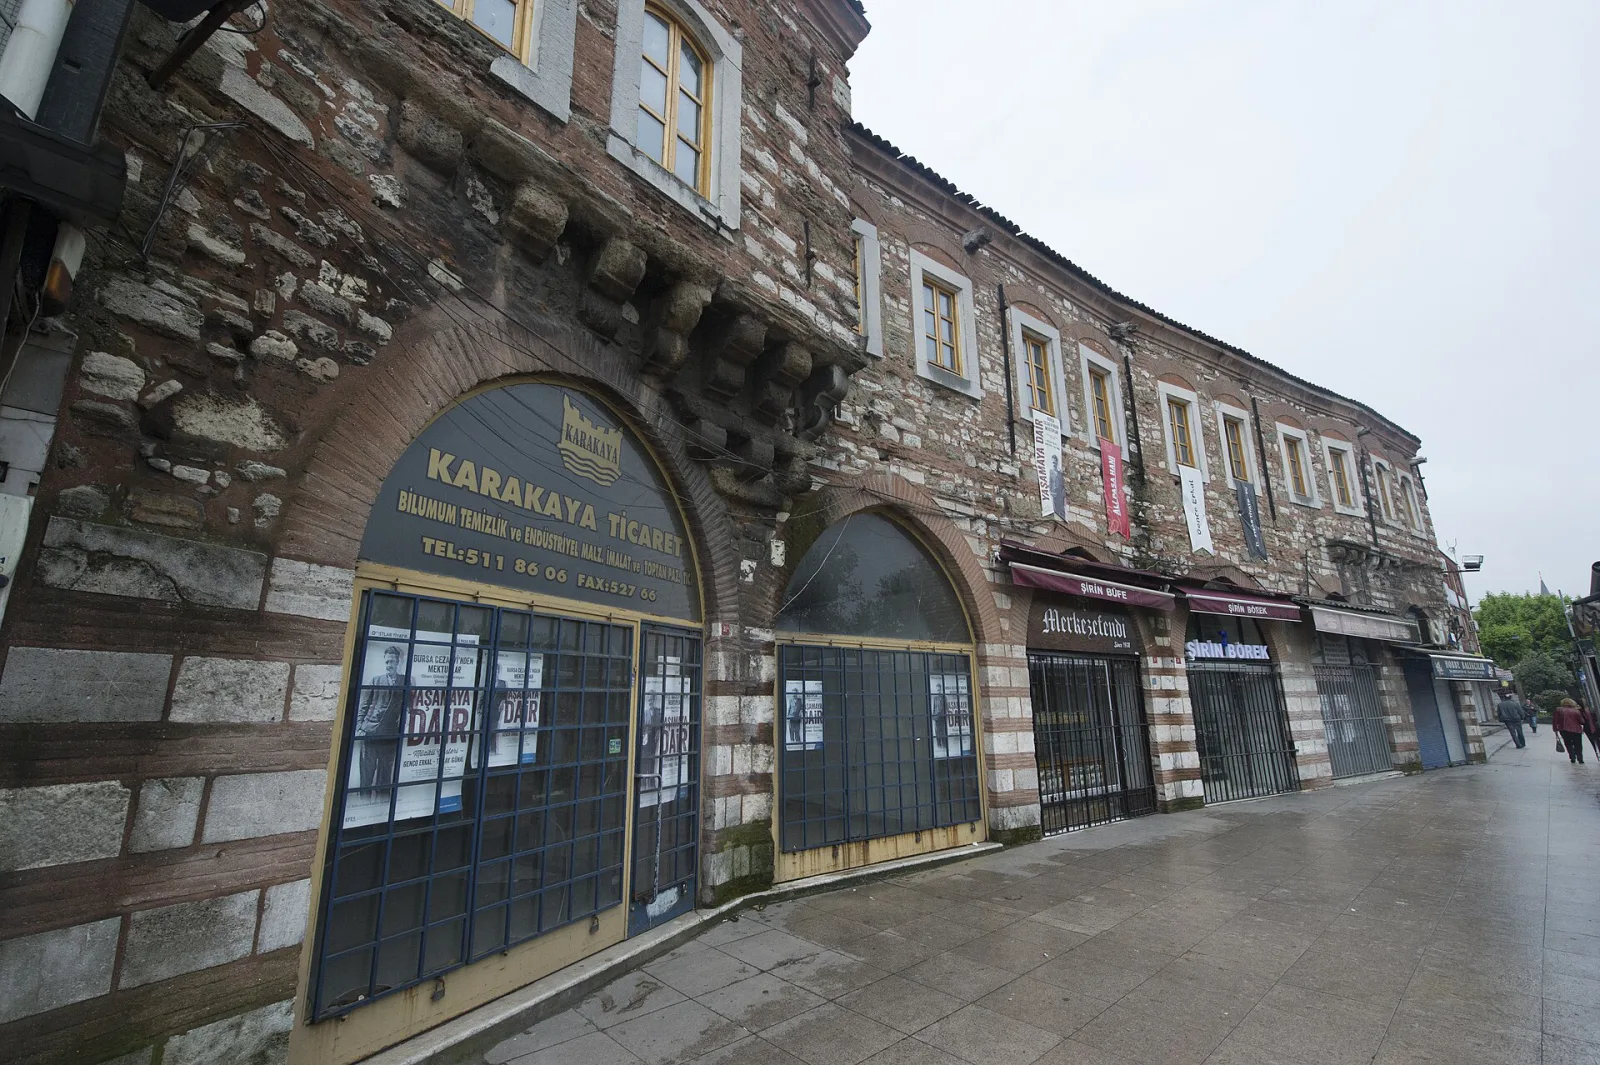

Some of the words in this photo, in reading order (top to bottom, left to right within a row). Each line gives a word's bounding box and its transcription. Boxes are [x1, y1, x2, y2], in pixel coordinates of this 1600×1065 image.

[565, 423, 618, 465] KARAKAYA
[427, 447, 597, 531] KARAKAYA
[608, 510, 683, 557] TİCARET
[398, 486, 457, 525] BİLUMUM
[460, 507, 508, 539] TEMİZLİK
[510, 527, 522, 541] ve
[524, 526, 579, 557] ENDÜSTRİYEL
[581, 543, 604, 564] MALZ.
[606, 546, 632, 572] İMALAT
[632, 562, 641, 573] ve
[514, 559, 539, 577] 86
[544, 566, 568, 583] 06
[640, 587, 657, 602] 66
[1080, 582, 1103, 595] ŞİRİN
[1106, 587, 1127, 599] BÜFE
[1247, 605, 1267, 615] BÖREK
[1042, 608, 1127, 640] Merkezefendi
[413, 654, 434, 664] BURSA
[434, 655, 474, 665] CEZAİ'NDEN
[1186, 639, 1223, 660] ŞİRİN
[1225, 642, 1270, 660] BÖREK
[428, 665, 462, 674] MEKTUAR
[504, 700, 538, 724] DAR
[407, 707, 469, 746] DAR
[403, 759, 418, 768] GENCO
[436, 757, 450, 765] TAY
